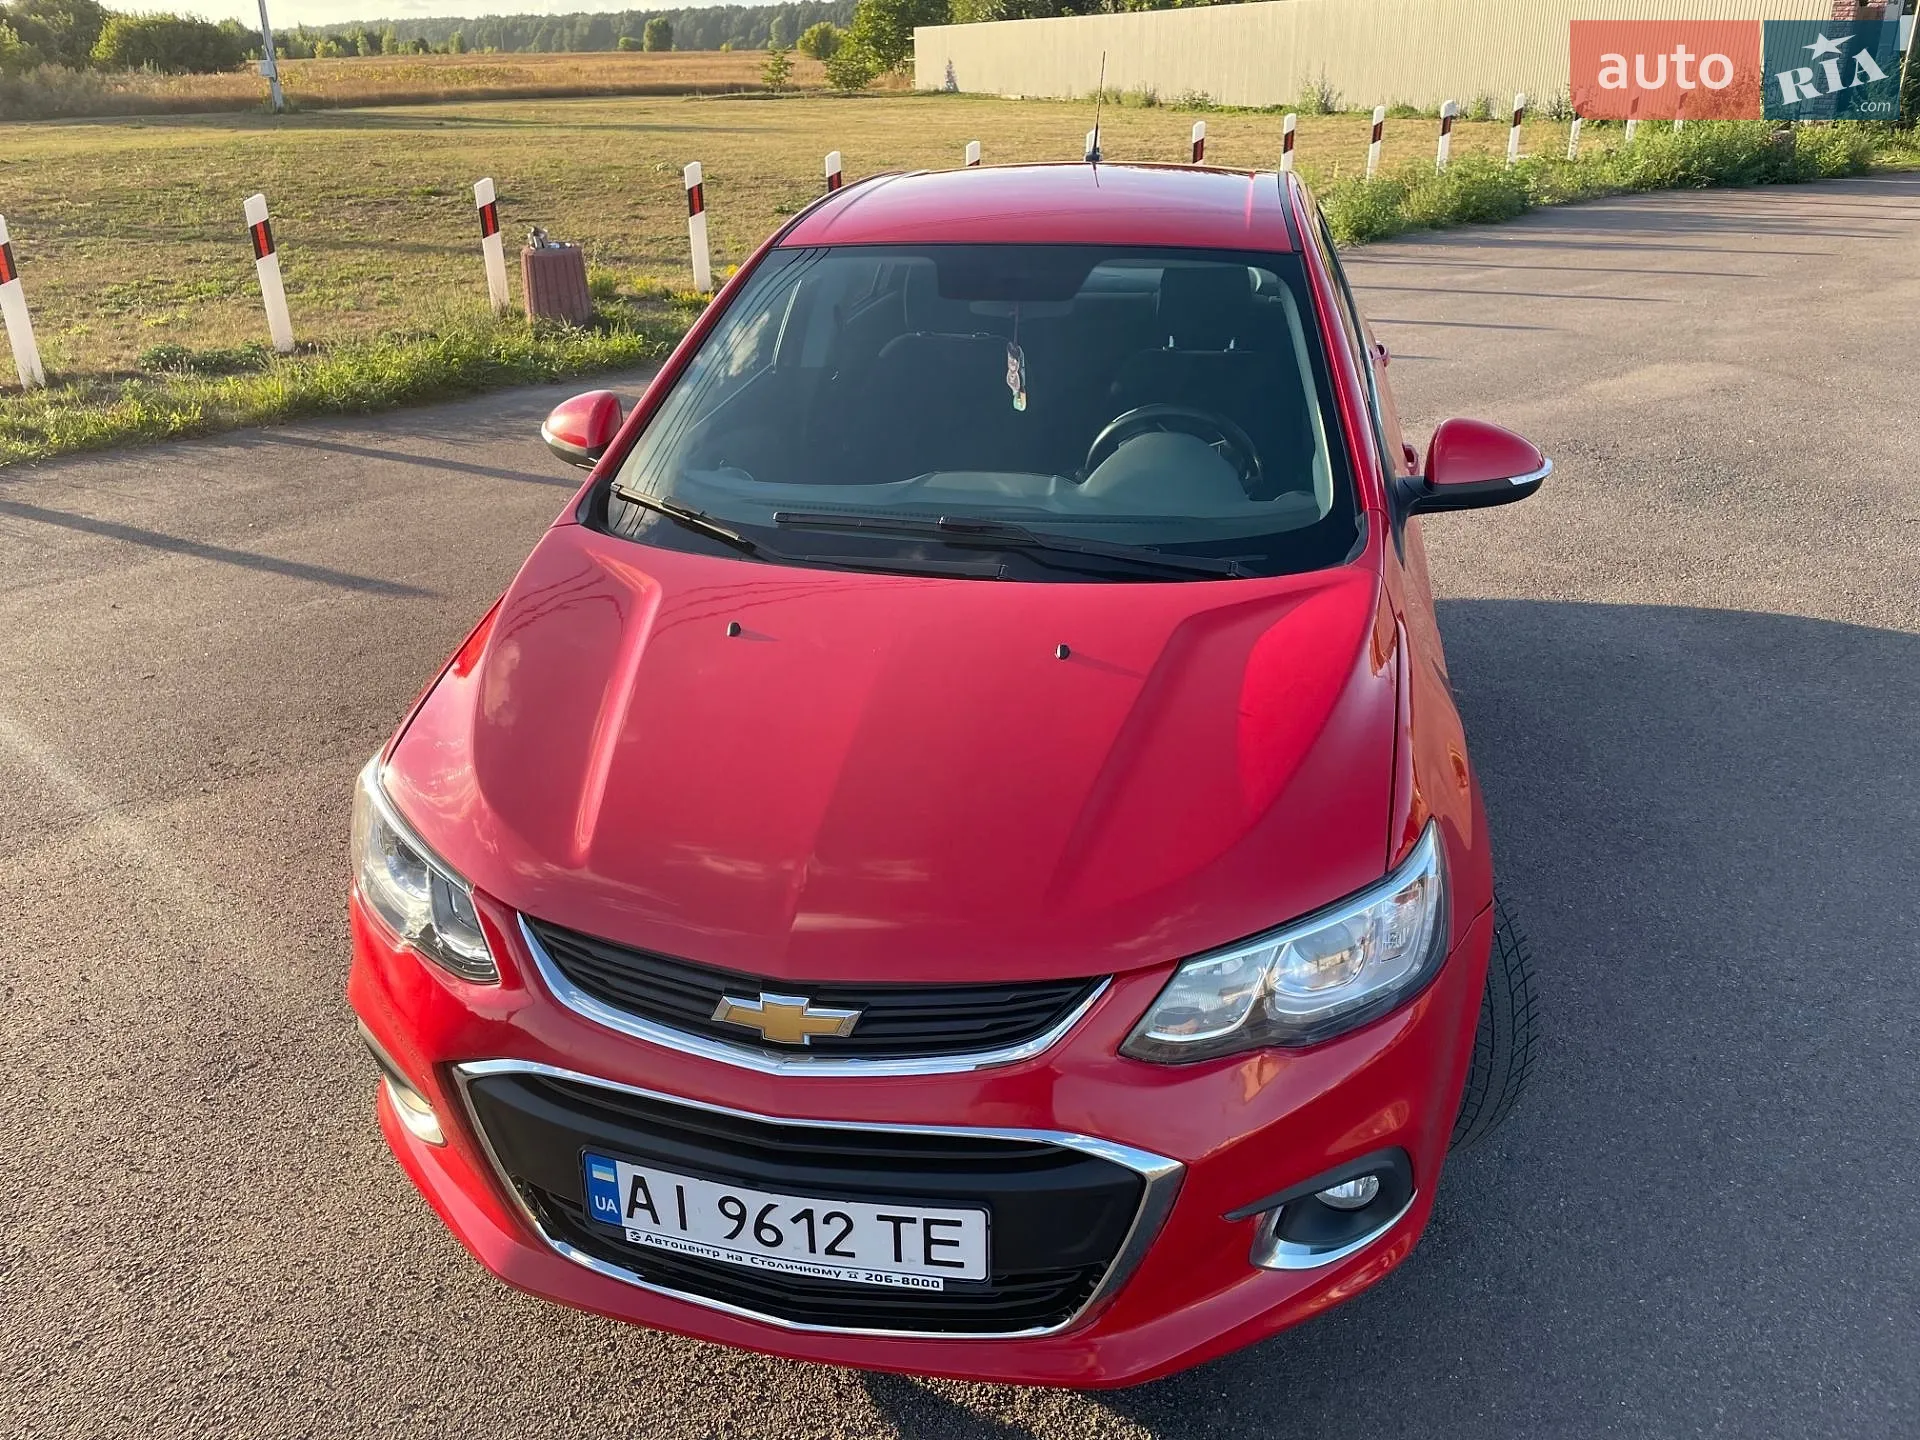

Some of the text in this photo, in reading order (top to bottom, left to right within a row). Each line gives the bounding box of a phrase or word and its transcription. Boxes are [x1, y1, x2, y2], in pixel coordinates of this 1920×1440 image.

[594, 1195, 618, 1214] UA
[626, 1174, 965, 1268] AI 9612 TE
[644, 1233, 941, 1290] Автоцентр на Столичному 206-8000
